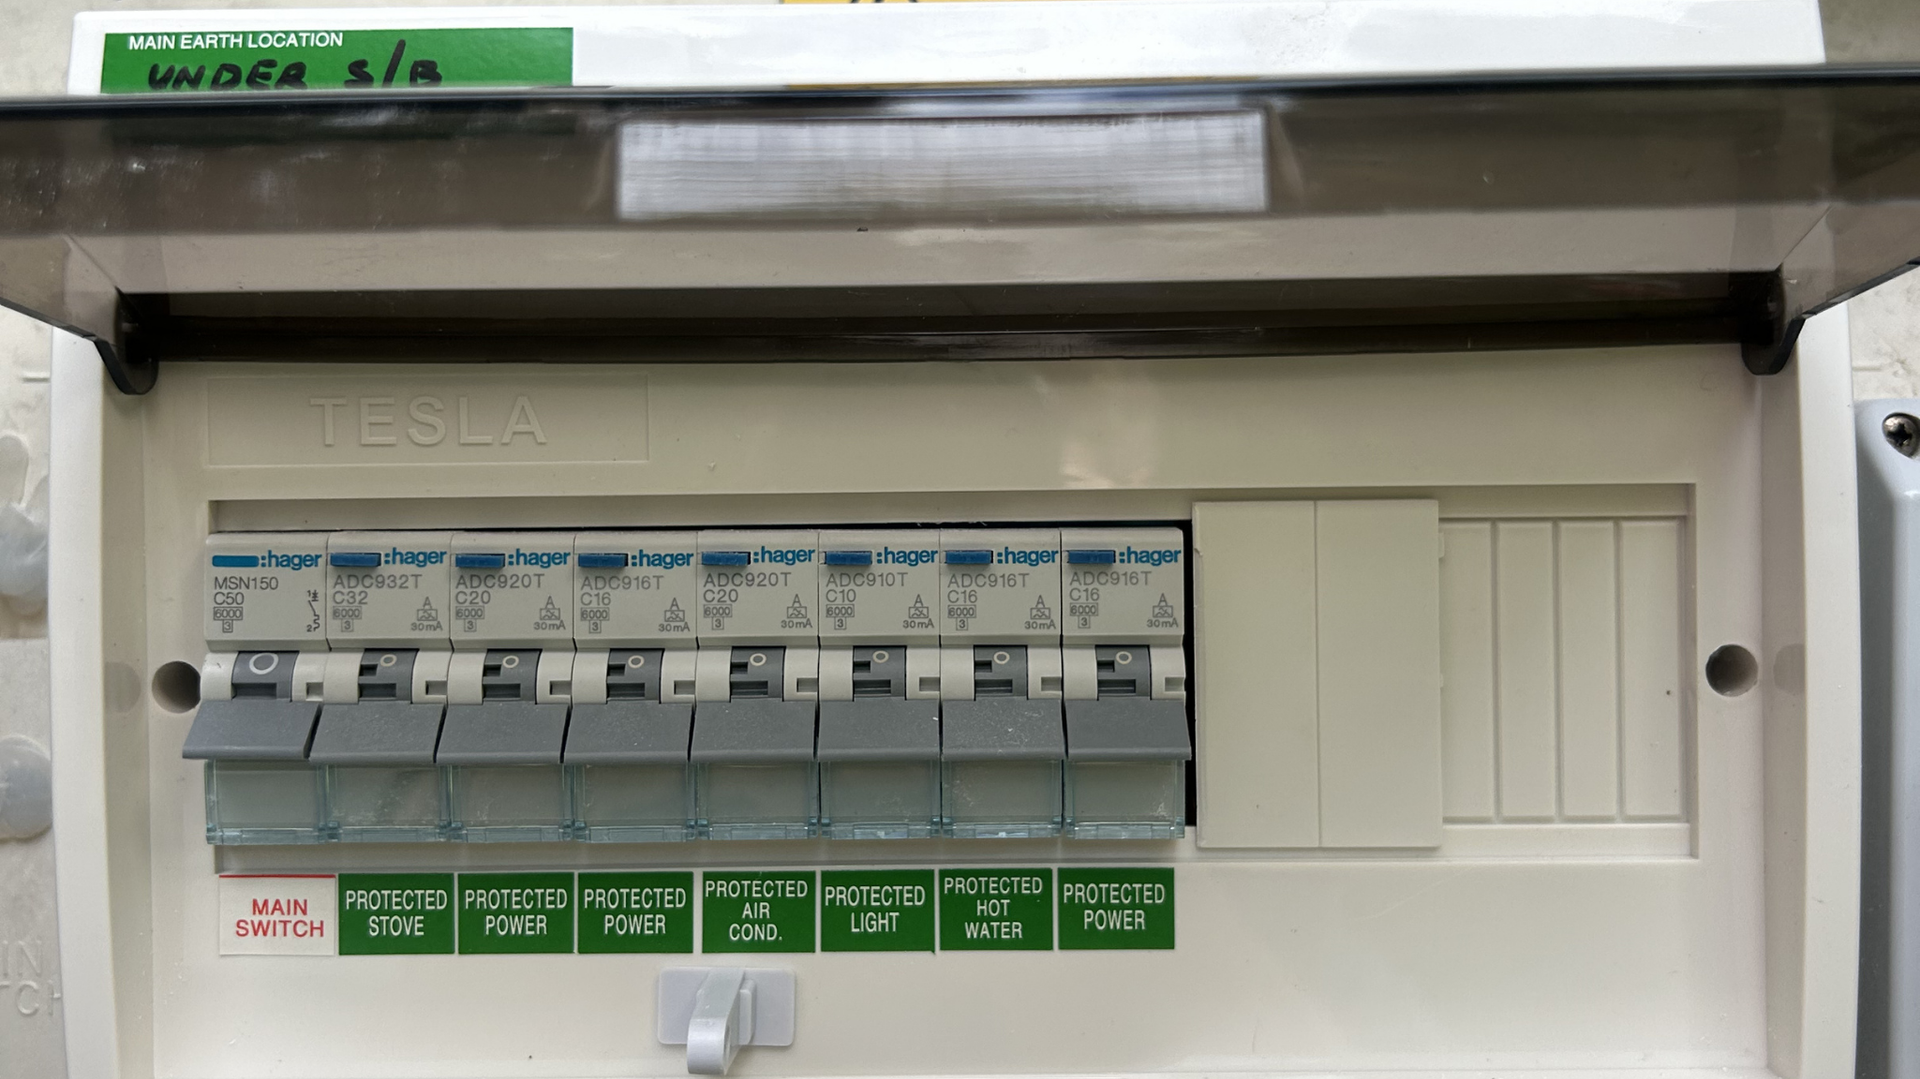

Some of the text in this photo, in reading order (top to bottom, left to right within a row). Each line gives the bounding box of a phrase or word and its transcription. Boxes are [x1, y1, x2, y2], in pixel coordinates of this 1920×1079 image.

[128, 32, 343, 50] MAIN EARTH LOCATION
[148, 59, 307, 91] UNDER
[310, 396, 547, 446] TESLA
[214, 576, 279, 590] MSN150
[333, 574, 422, 589] ADC932T
[455, 574, 545, 588] ADC920T
[580, 576, 664, 590] ADC916T
[703, 572, 791, 587] ADC920T
[826, 572, 908, 587] ADC910T
[947, 573, 1030, 588] ADC916T
[1070, 571, 1152, 586] ADC916T
[214, 592, 244, 605] C50
[333, 591, 368, 604] C32
[455, 591, 491, 604] C20
[580, 592, 611, 606] C16
[703, 589, 739, 603] C20
[826, 589, 856, 603] C10
[947, 590, 978, 603] C16
[1070, 588, 1100, 601] C16
[214, 608, 242, 619] 6000
[333, 609, 360, 618] 6000
[456, 609, 483, 618] 6000
[581, 610, 608, 619] 6000
[704, 607, 731, 616] 6000
[827, 607, 853, 616] 6000
[948, 608, 974, 616] 6000
[1071, 605, 1096, 614] 6000
[706, 880, 808, 898] PROTECTED
[944, 877, 1042, 895] PROTECTED
[1064, 883, 1165, 904] PROTECTED
[346, 890, 447, 910] PROTECTED
[465, 889, 568, 910] PROTECTED
[584, 888, 686, 909] PROTECTED
[825, 886, 925, 906] PROTECTED
[251, 898, 308, 917] MAIN
[742, 902, 770, 919] AIR
[977, 900, 1009, 917] HOT
[368, 916, 424, 936] STOVE
[486, 914, 548, 936] POWER
[604, 914, 666, 935] POWER
[851, 912, 899, 933] LIGHT
[1084, 910, 1146, 930] POWER
[235, 920, 325, 938] SWITCH
[729, 924, 783, 941] COND.
[965, 922, 1022, 939] WATER
